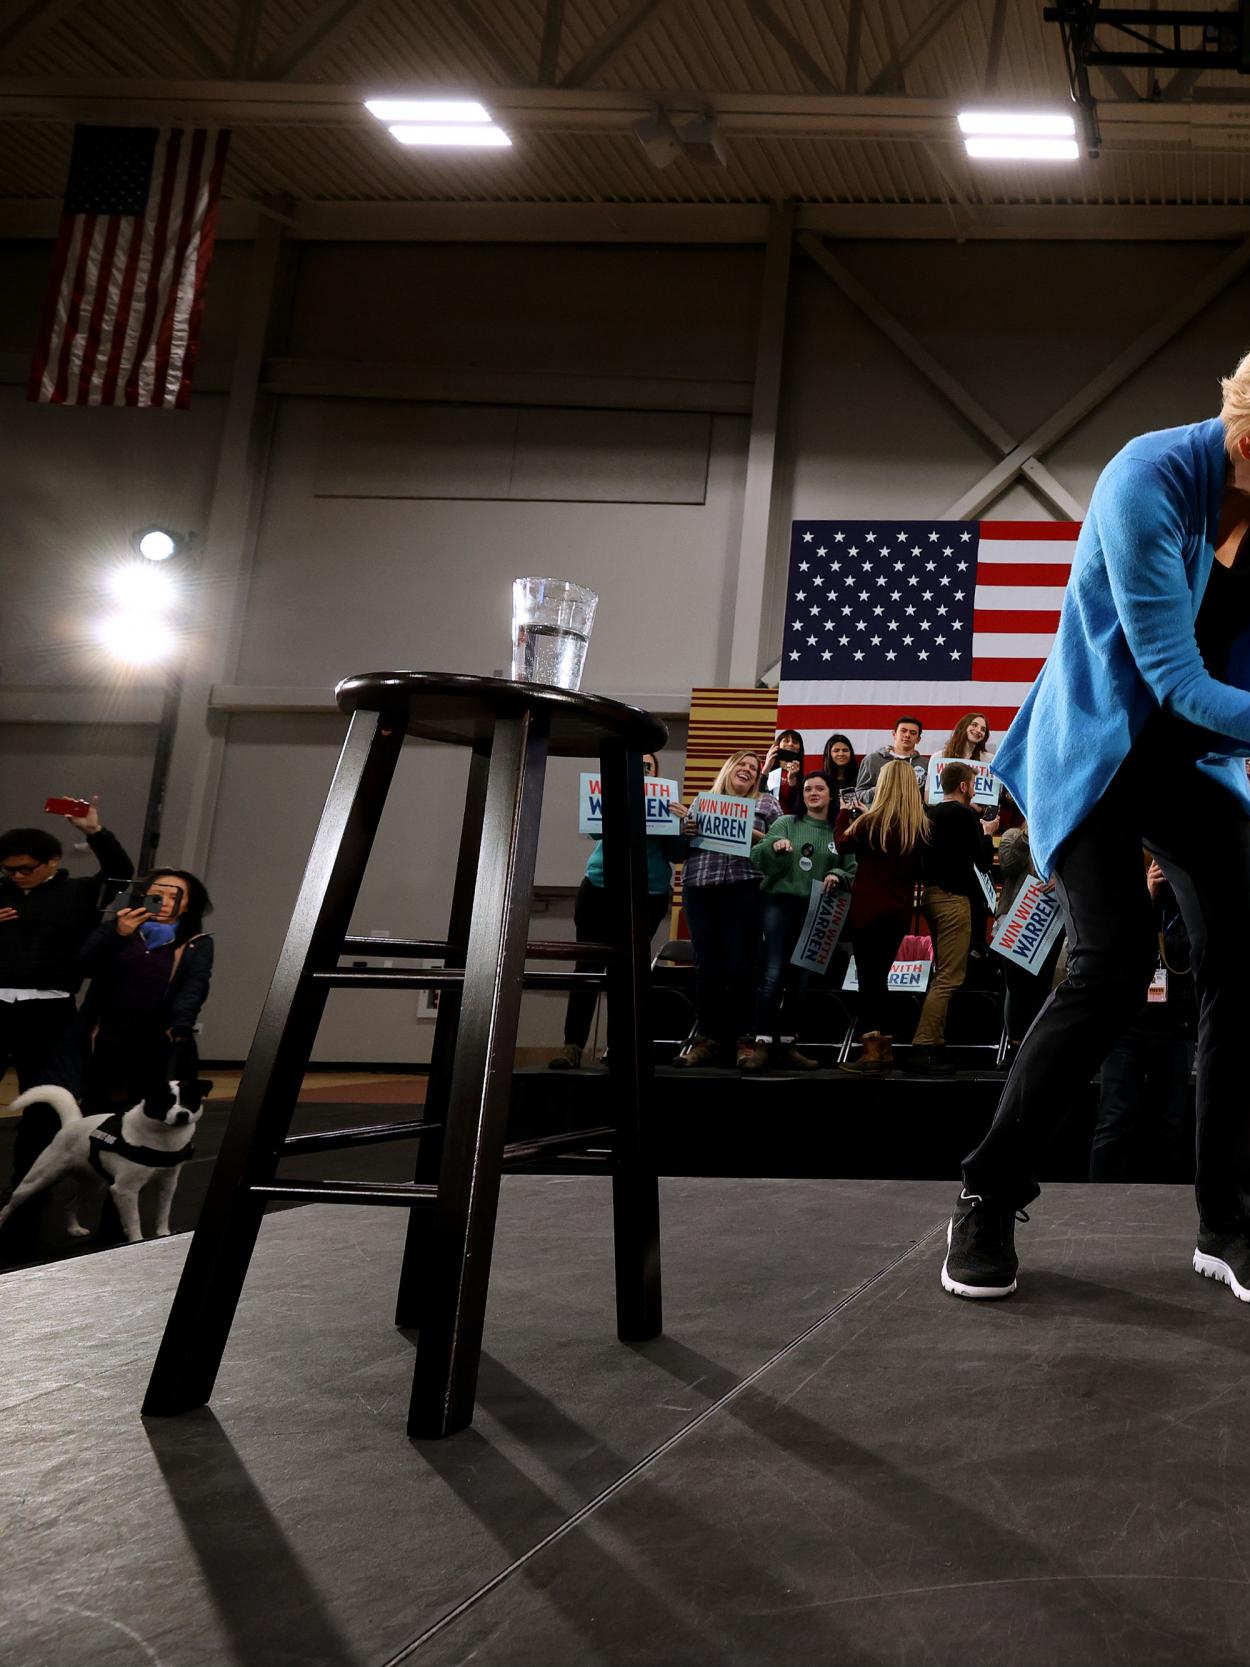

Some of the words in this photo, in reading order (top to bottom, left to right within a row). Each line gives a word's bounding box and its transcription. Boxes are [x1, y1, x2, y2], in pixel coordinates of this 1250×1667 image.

[644, 783, 670, 797] ITH
[589, 796, 670, 817] WEN
[698, 798, 718, 814] WIN
[720, 801, 748, 819] WITH
[695, 813, 747, 839] WARREN
[832, 896, 847, 926] WIN
[998, 919, 1024, 950] WIN
[1014, 883, 1041, 921] WITH
[1012, 892, 1057, 959] WARREN
[805, 893, 837, 962] WARREN
[816, 928, 838, 966] WITH
